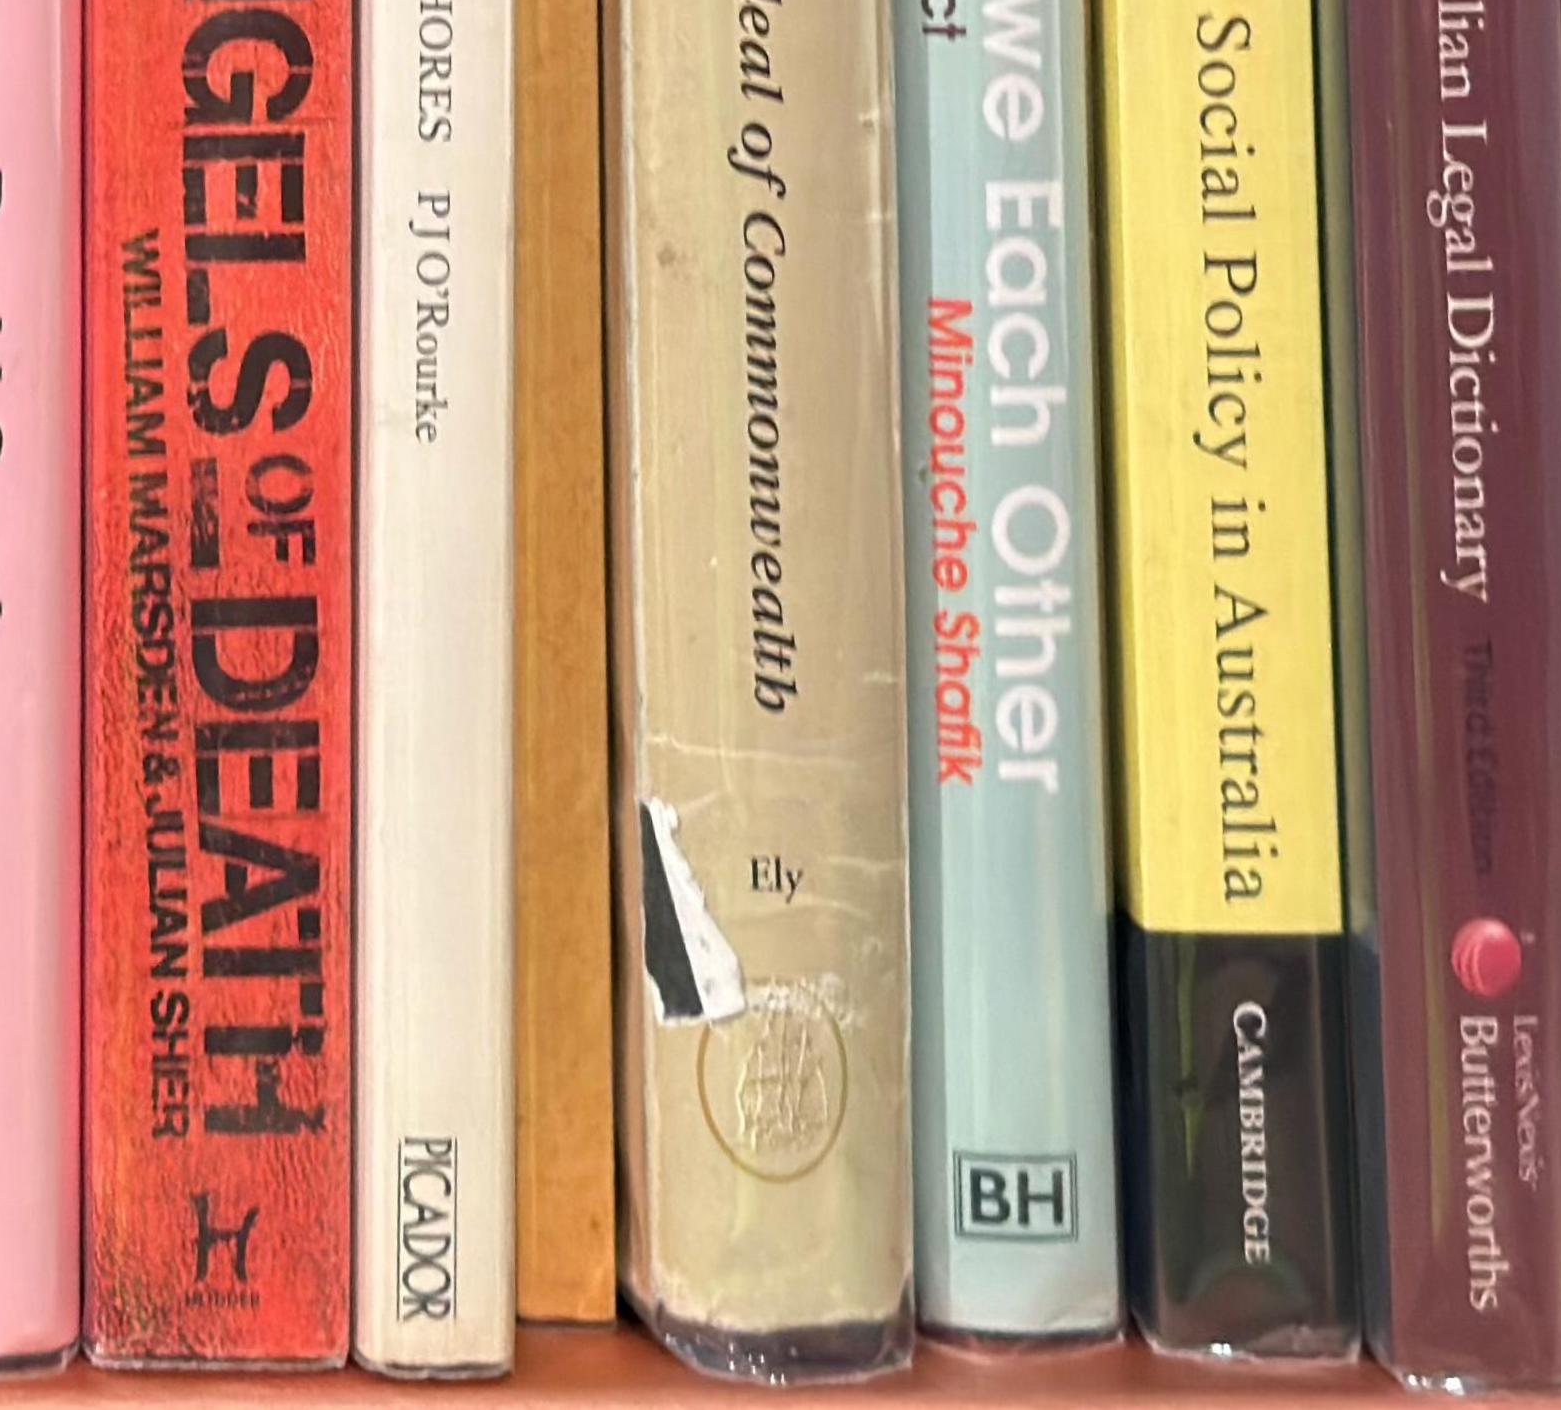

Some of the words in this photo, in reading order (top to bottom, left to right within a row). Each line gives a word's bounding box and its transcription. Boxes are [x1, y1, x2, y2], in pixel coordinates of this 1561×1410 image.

[1198, 14, 1257, 226] Social
[1427, 120, 1495, 273] Legal
[122, 227, 166, 456] WILLIAM
[928, 297, 976, 592] Minouche
[986, 181, 1066, 446] Each
[1193, 251, 1261, 470] Policy
[744, 210, 798, 714] Commonwealth
[1441, 292, 1498, 603] Dictionary
[130, 471, 178, 743] MARSDEN
[934, 610, 982, 785] Shafik
[993, 487, 1071, 793] Other
[192, 596, 325, 1136] DEATH
[1214, 584, 1280, 905] Australia
[146, 795, 188, 978] JULIAN
[751, 857, 803, 902] Ely
[151, 989, 189, 1139] SHER
[1234, 1002, 1270, 1264] CAMBRIDGE
[1460, 1016, 1508, 1311] Butterworths
[403, 1138, 451, 1320] PICADOR
